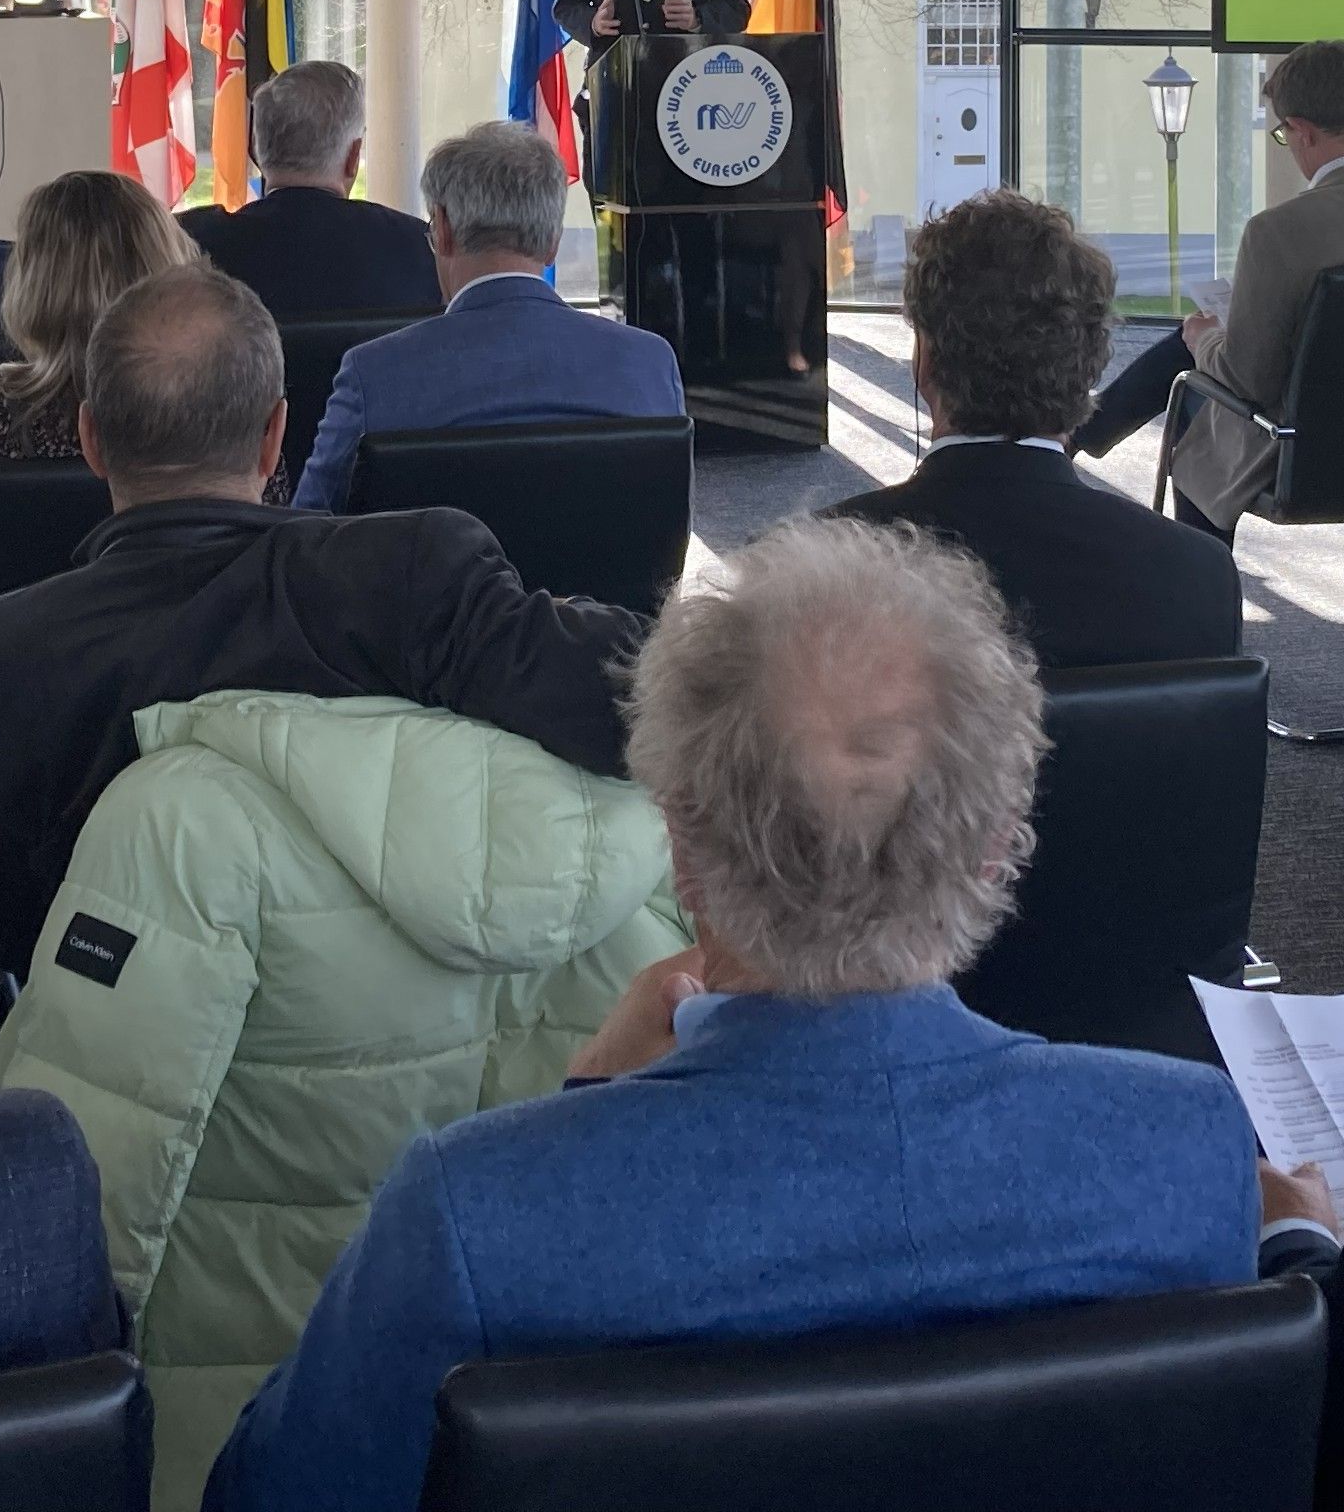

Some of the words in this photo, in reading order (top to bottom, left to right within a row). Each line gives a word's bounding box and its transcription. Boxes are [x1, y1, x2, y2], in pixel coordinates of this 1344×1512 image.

[666, 69, 698, 156] RIJN-WAAL
[750, 65, 784, 152] RHEIN-WAAL
[692, 155, 761, 178] EUREGIO
